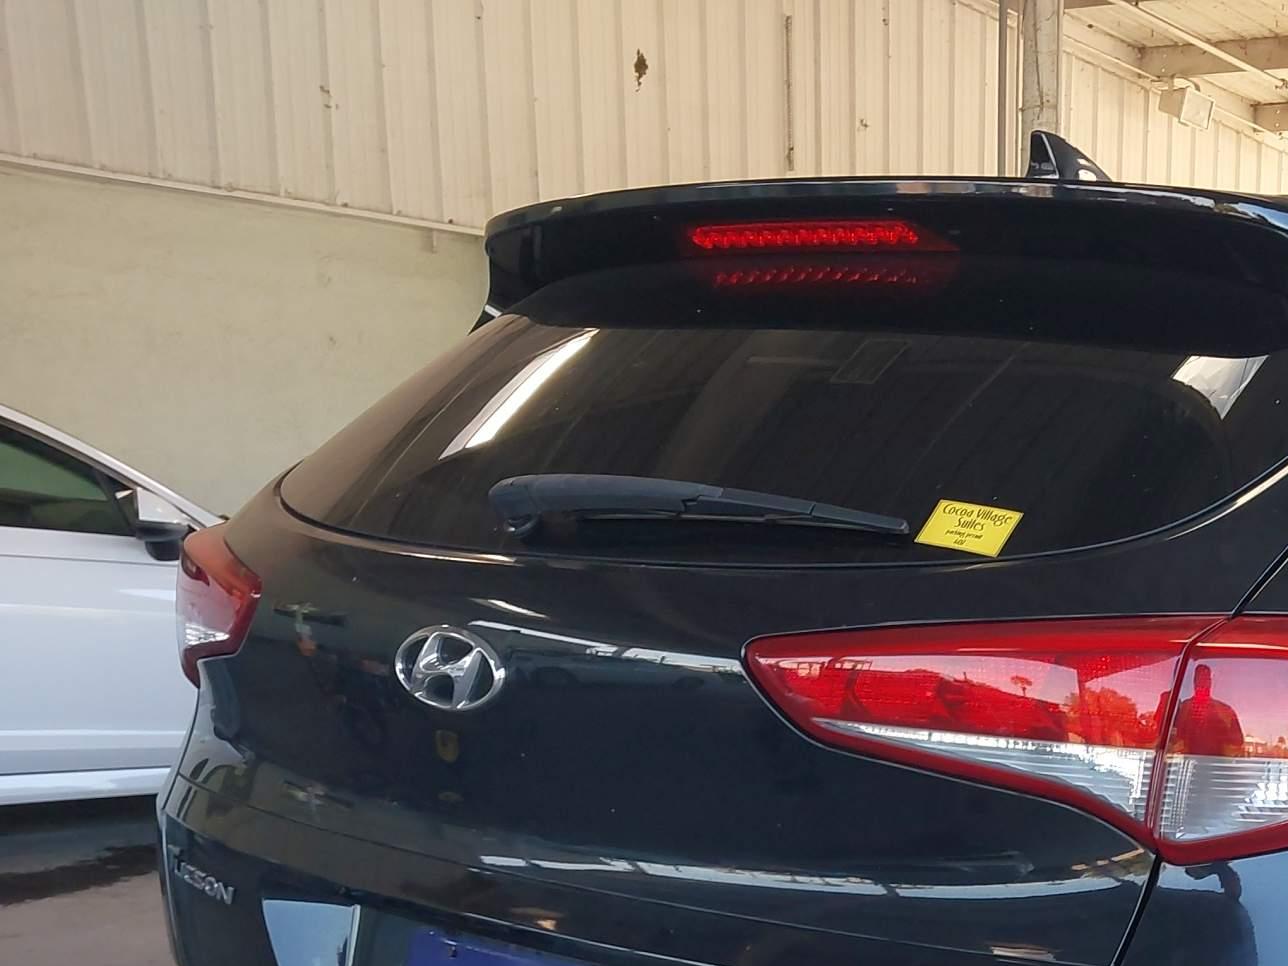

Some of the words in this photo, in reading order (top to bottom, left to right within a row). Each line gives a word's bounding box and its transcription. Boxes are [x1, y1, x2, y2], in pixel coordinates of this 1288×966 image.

[943, 503, 975, 518] Cocoa
[976, 508, 1013, 526] Village
[954, 516, 985, 531] Suites
